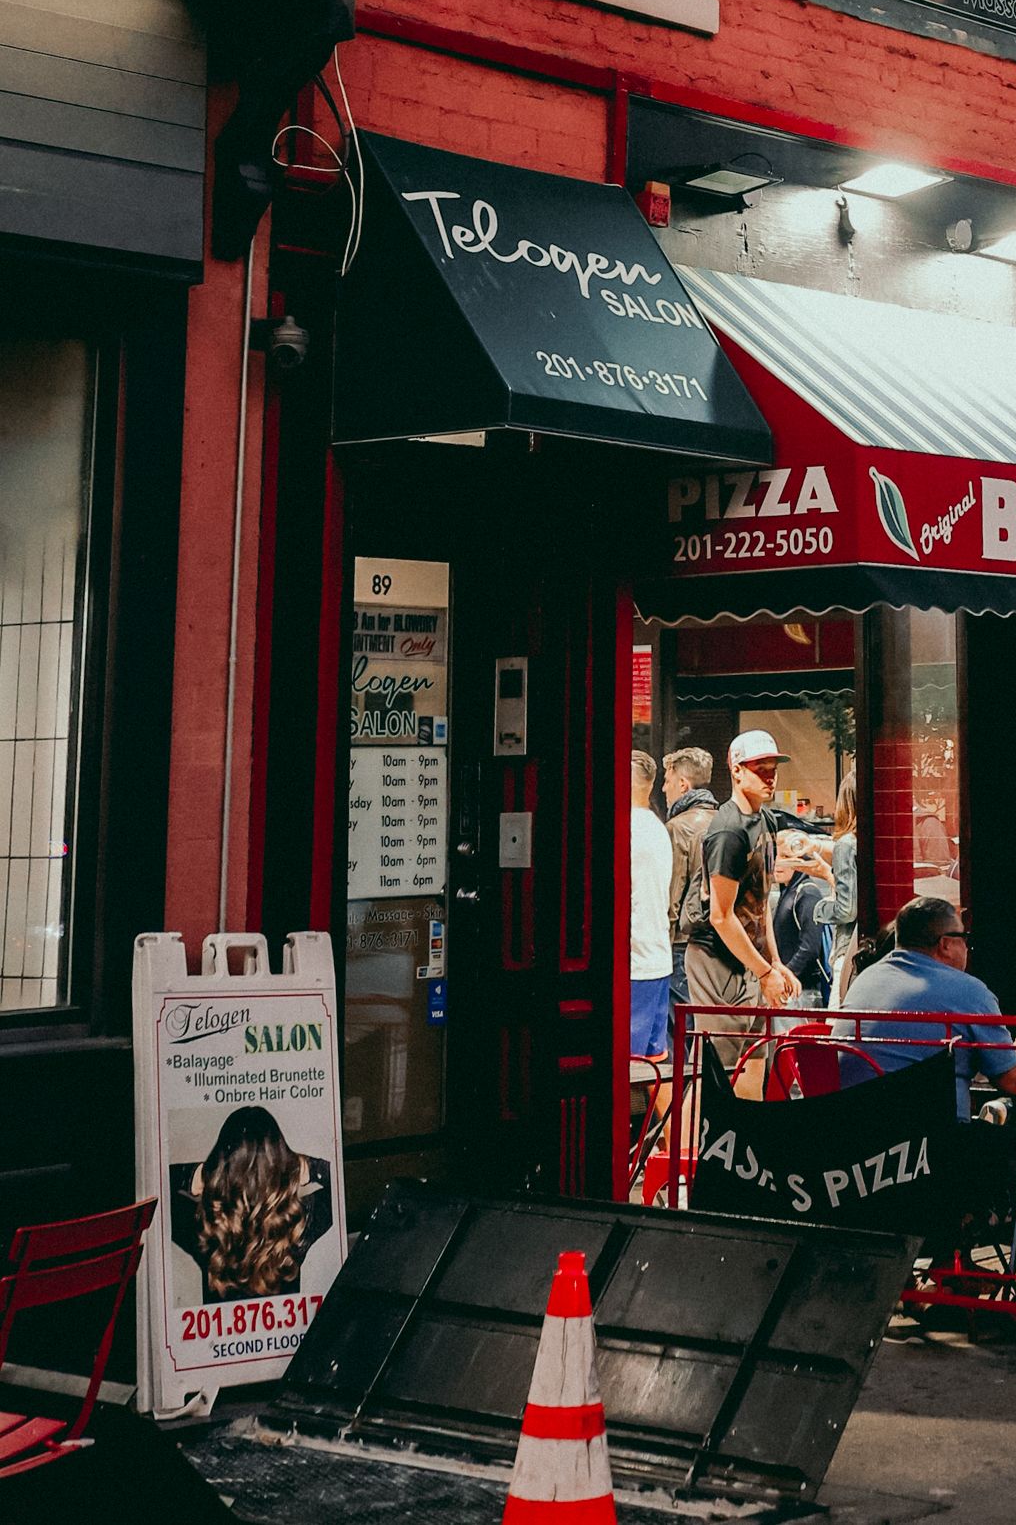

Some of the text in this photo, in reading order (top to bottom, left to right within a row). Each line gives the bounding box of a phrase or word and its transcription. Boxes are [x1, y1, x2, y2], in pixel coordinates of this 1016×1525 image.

[401, 191, 662, 299] Telogen
[600, 289, 703, 329] SALON
[667, 465, 839, 523] PIZZA
[920, 481, 977, 555] Original
[673, 526, 833, 562] 201-222-5050
[372, 574, 392, 596] 89
[400, 636, 437, 657] Only
[383, 755, 438, 769] 10am 9pm
[382, 774, 438, 788] 10am 9pm
[382, 796, 405, 807] 10am
[418, 795, 437, 809] 9pm
[381, 814, 437, 829] 10am 9pm
[380, 834, 437, 849] 10am 9pm
[380, 854, 436, 868] 10am 6pm
[380, 874, 433, 887] 11am 6pm
[166, 1002, 251, 1039] Telogen
[431, 1010, 444, 1018] VISA
[244, 1023, 323, 1054] SALON
[194, 1067, 325, 1087] Illuminated Brunette
[215, 1084, 324, 1103] Onbre Hair Color
[823, 1137, 931, 1208] PIZZA
[182, 1295, 323, 1341] 201.876.317
[213, 1338, 263, 1358] SECOND
